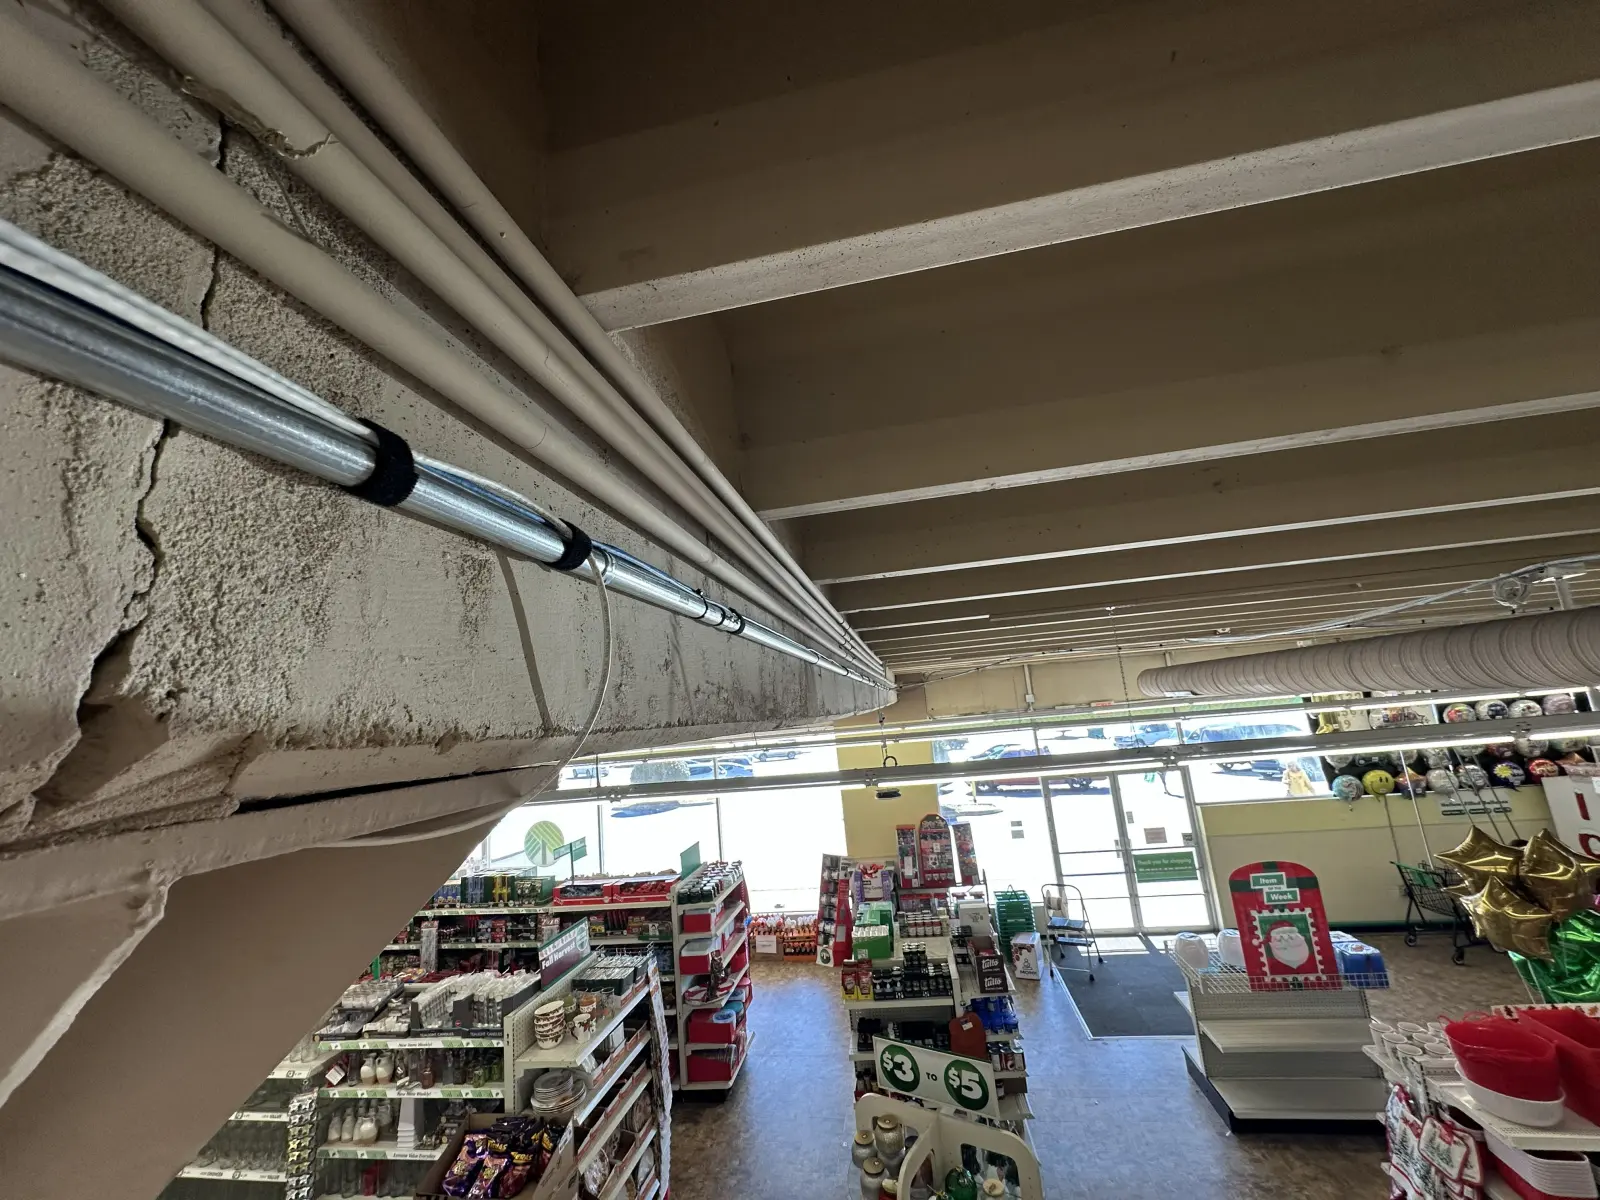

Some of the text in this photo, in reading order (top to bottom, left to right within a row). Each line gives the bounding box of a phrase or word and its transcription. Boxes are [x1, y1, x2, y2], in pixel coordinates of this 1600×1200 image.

[541, 941, 575, 970] Fall Harvest
[882, 1051, 983, 1100] $3 TO $5
